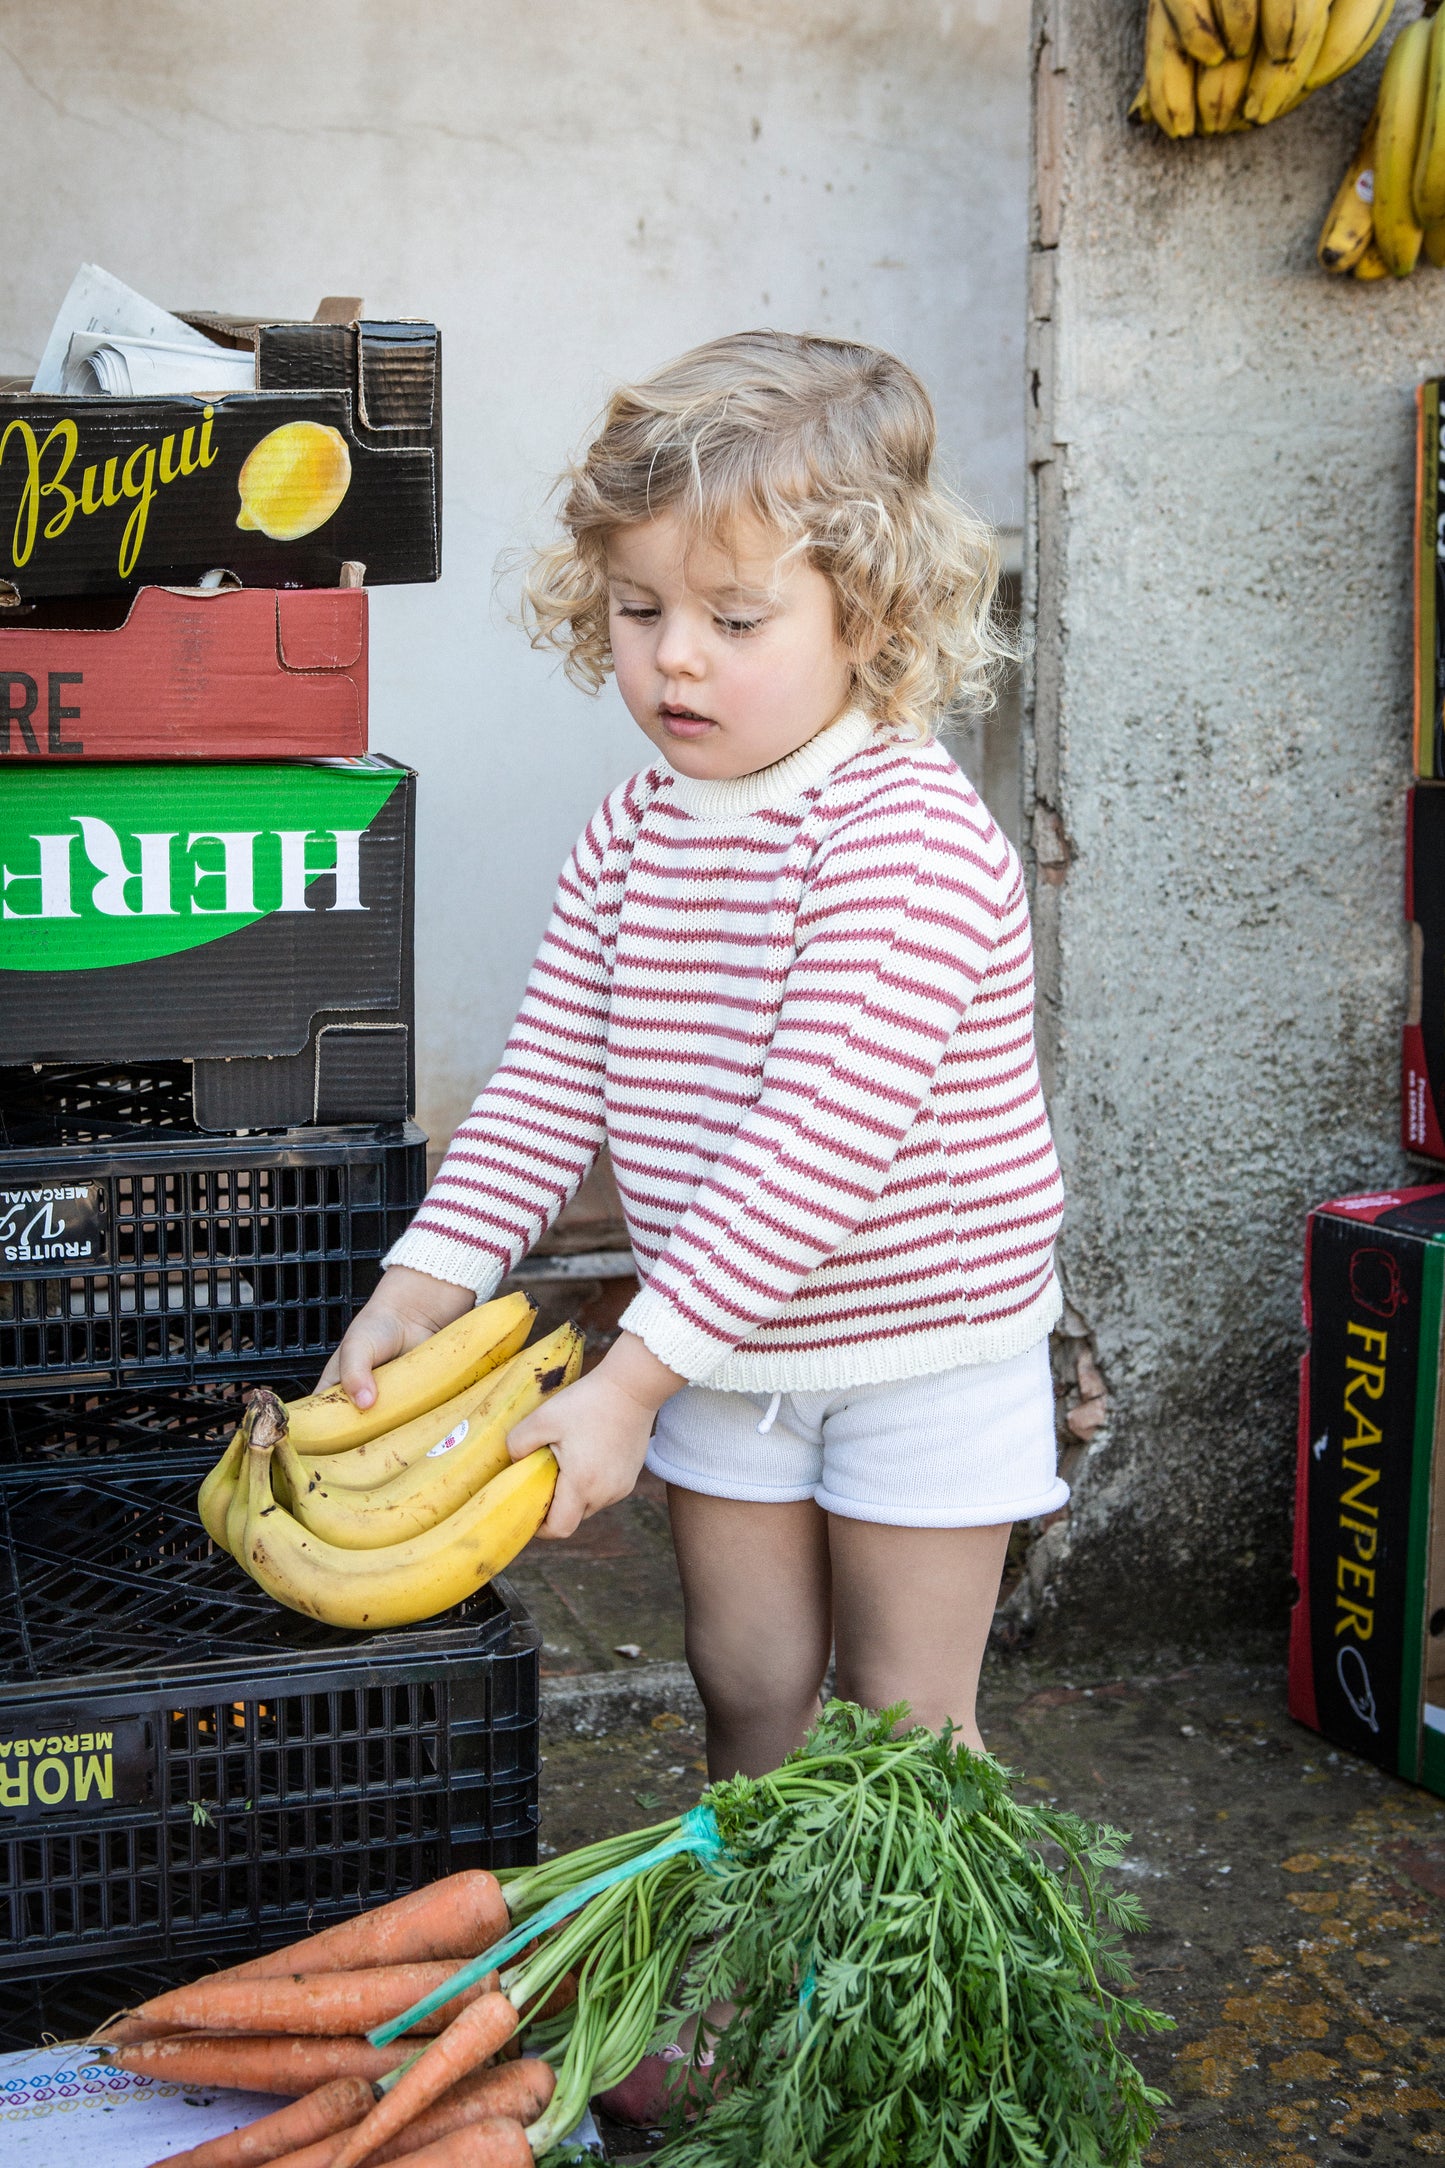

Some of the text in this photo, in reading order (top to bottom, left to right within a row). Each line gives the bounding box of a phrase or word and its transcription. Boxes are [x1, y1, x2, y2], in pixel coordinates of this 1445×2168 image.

[0, 405, 219, 579] Bugui
[0, 671, 83, 754] RE
[3, 816, 371, 919] HERF
[0, 1186, 89, 1204] MERCAVAL
[4, 1240, 92, 1261] FRUITES
[1335, 1320, 1388, 1640] FRANPER
[0, 1732, 113, 1758] MERCABA
[0, 1753, 114, 1807] MOR
